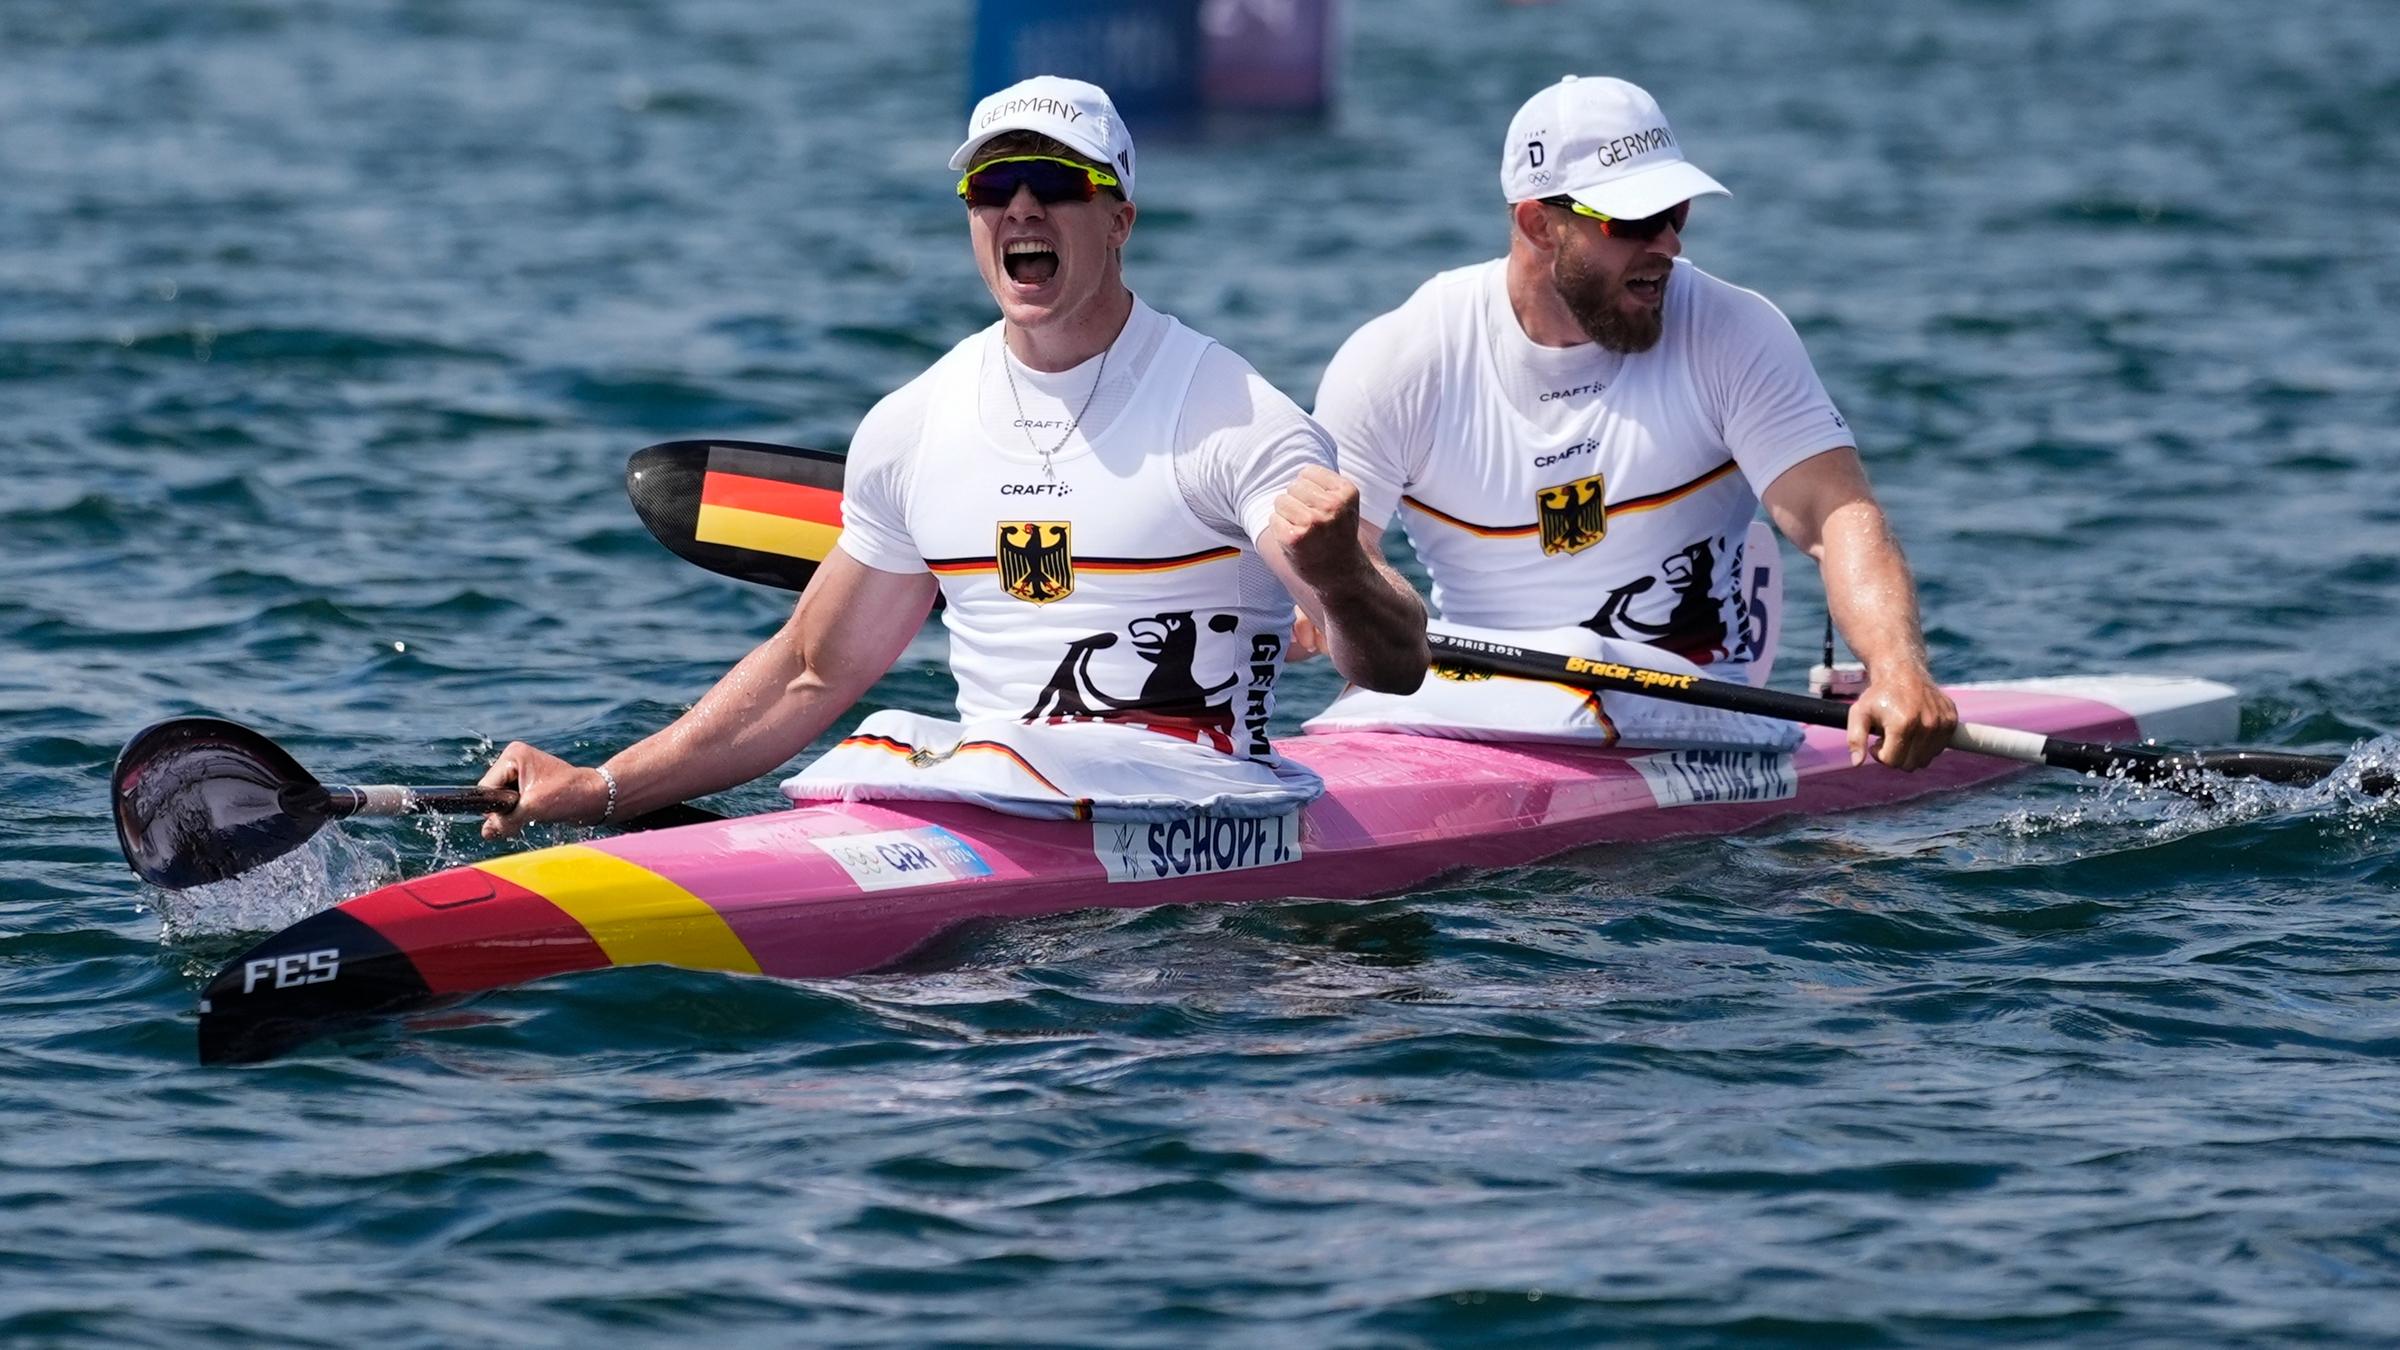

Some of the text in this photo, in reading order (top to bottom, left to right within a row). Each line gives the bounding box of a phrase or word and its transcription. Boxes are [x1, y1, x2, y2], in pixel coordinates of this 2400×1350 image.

[980, 97, 1083, 129] GERMANY
[1597, 127, 1676, 167] GERMAN
[1539, 385, 1592, 402] CRAFT
[1013, 420, 1063, 429] CRAFT
[1533, 443, 1585, 468] CRAFT
[1000, 484, 1057, 495] CRAFT
[1448, 638, 1524, 657] PARIS 2024
[875, 842, 937, 872] GER
[1147, 816, 1290, 877] SCHOPF J.
[243, 949, 340, 994] FES
